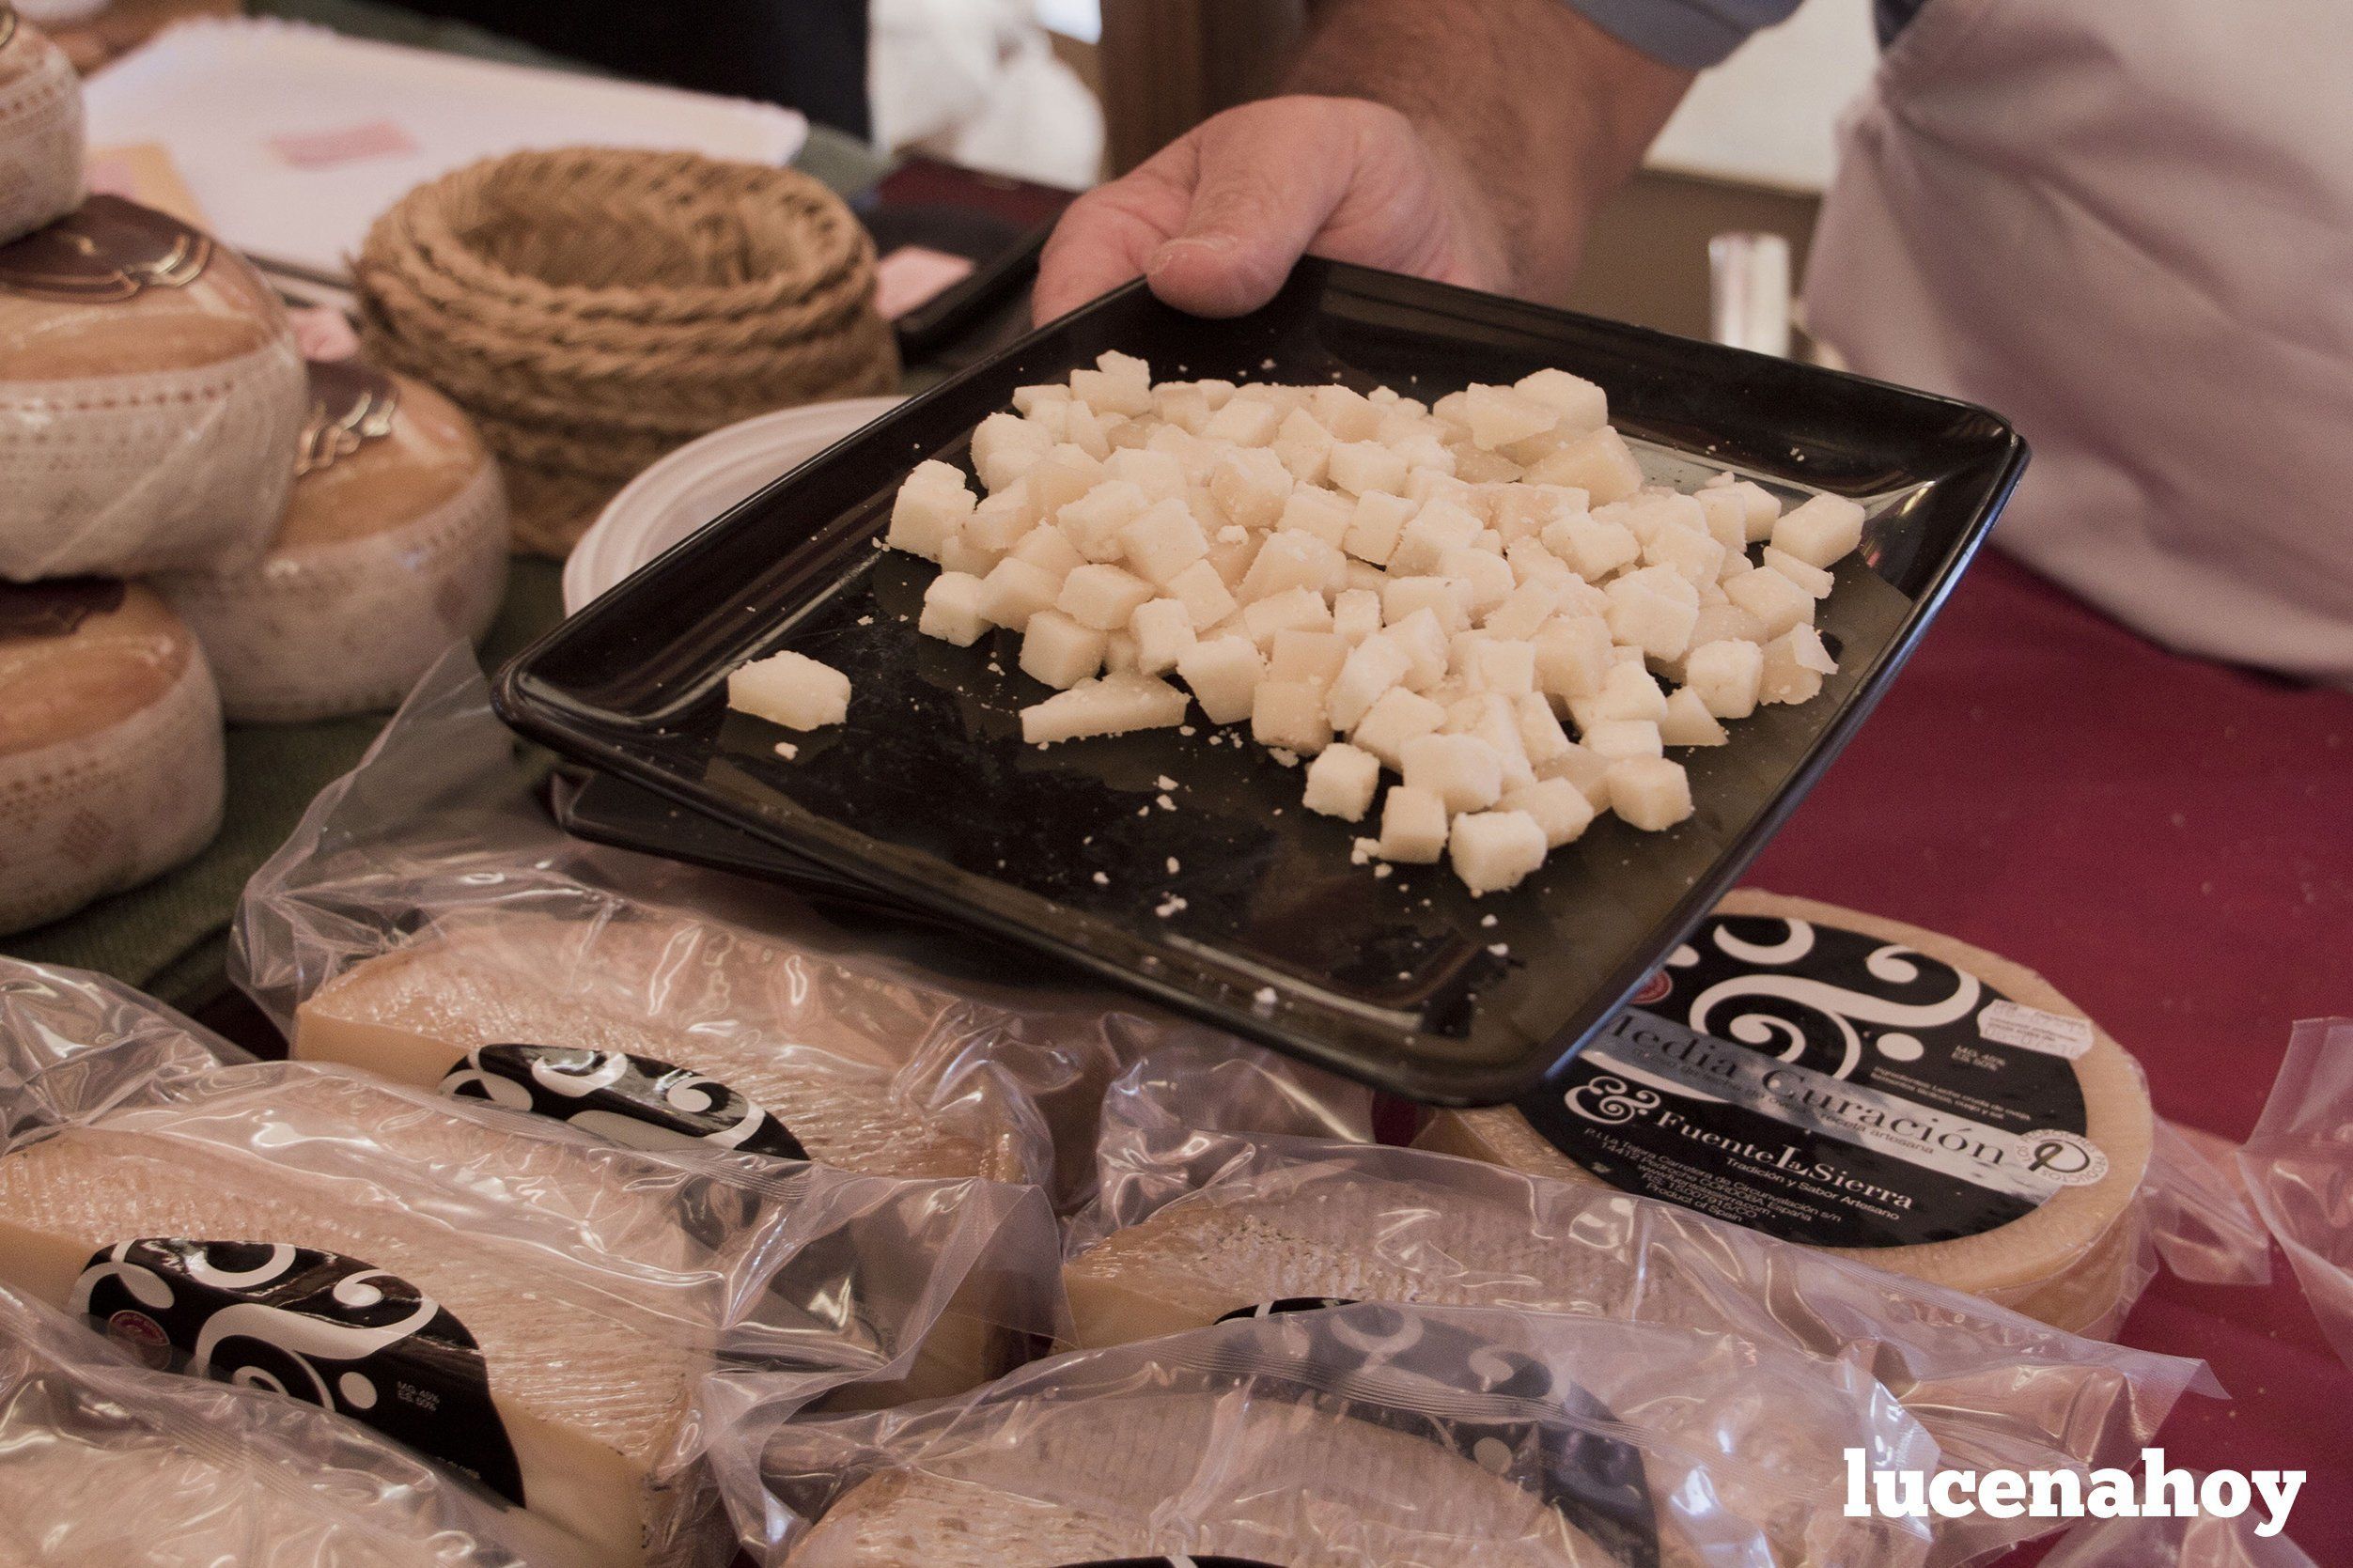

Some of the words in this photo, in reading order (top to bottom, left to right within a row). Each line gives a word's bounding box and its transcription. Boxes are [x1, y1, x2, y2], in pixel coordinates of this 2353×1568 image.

[1762, 1068, 2004, 1165] Curación
[1869, 1129, 1934, 1155] artesana
[1601, 1141, 1641, 1160] 14412
[1641, 1156, 1698, 1182] Pedroche
[1645, 1182, 1692, 1204] Product
[1694, 1200, 1707, 1209] of
[1707, 1205, 1743, 1223] Spain
[1658, 1156, 1713, 1179] Carretera
[1715, 1175, 1732, 1186] de
[1733, 1182, 1819, 1215] Circunvalación
[1820, 1210, 1842, 1222] s/n
[1726, 1157, 1785, 1184] Tradición
[1785, 1177, 1797, 1188] y
[1798, 1181, 1839, 1200] Sabor
[1840, 1195, 1900, 1219] Artesano
